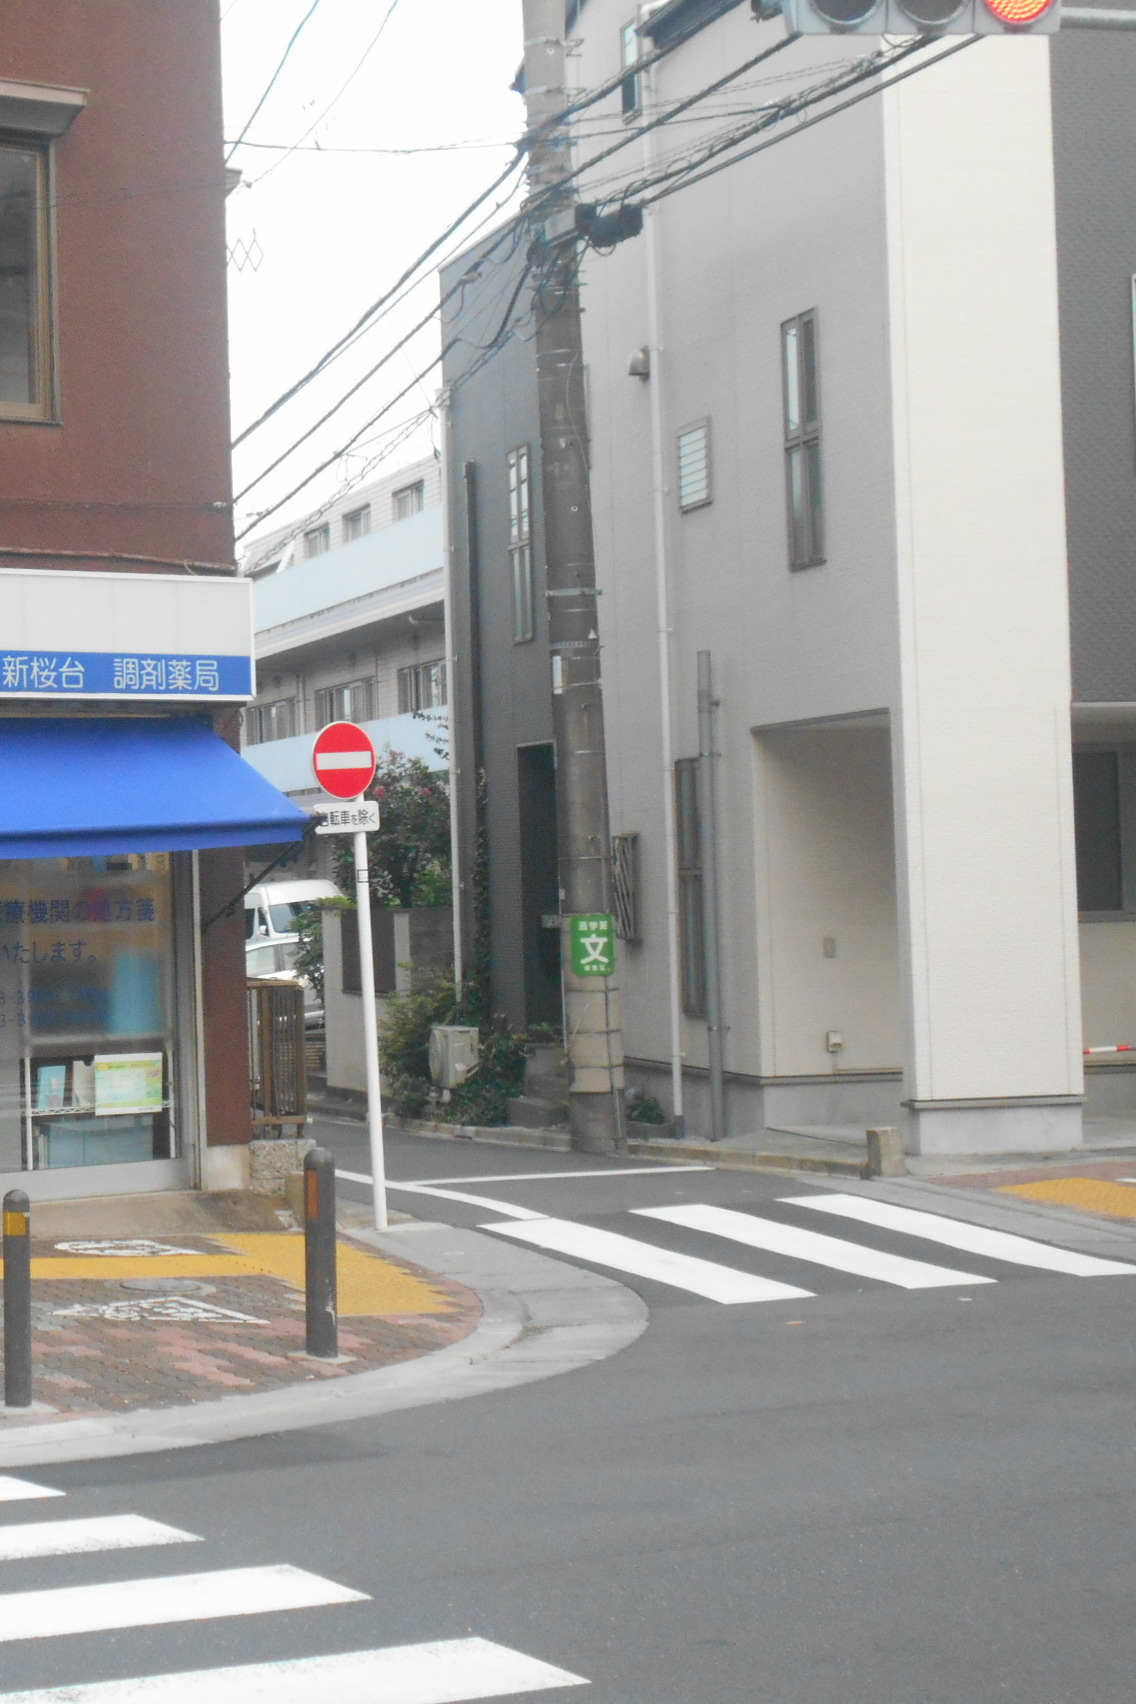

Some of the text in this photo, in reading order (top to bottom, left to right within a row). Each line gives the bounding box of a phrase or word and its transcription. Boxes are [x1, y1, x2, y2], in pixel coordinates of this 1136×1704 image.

[2, 655, 220, 691] 新桜台 調剤薬局
[320, 808, 375, 827] 転車を除く
[580, 933, 609, 965] 文
